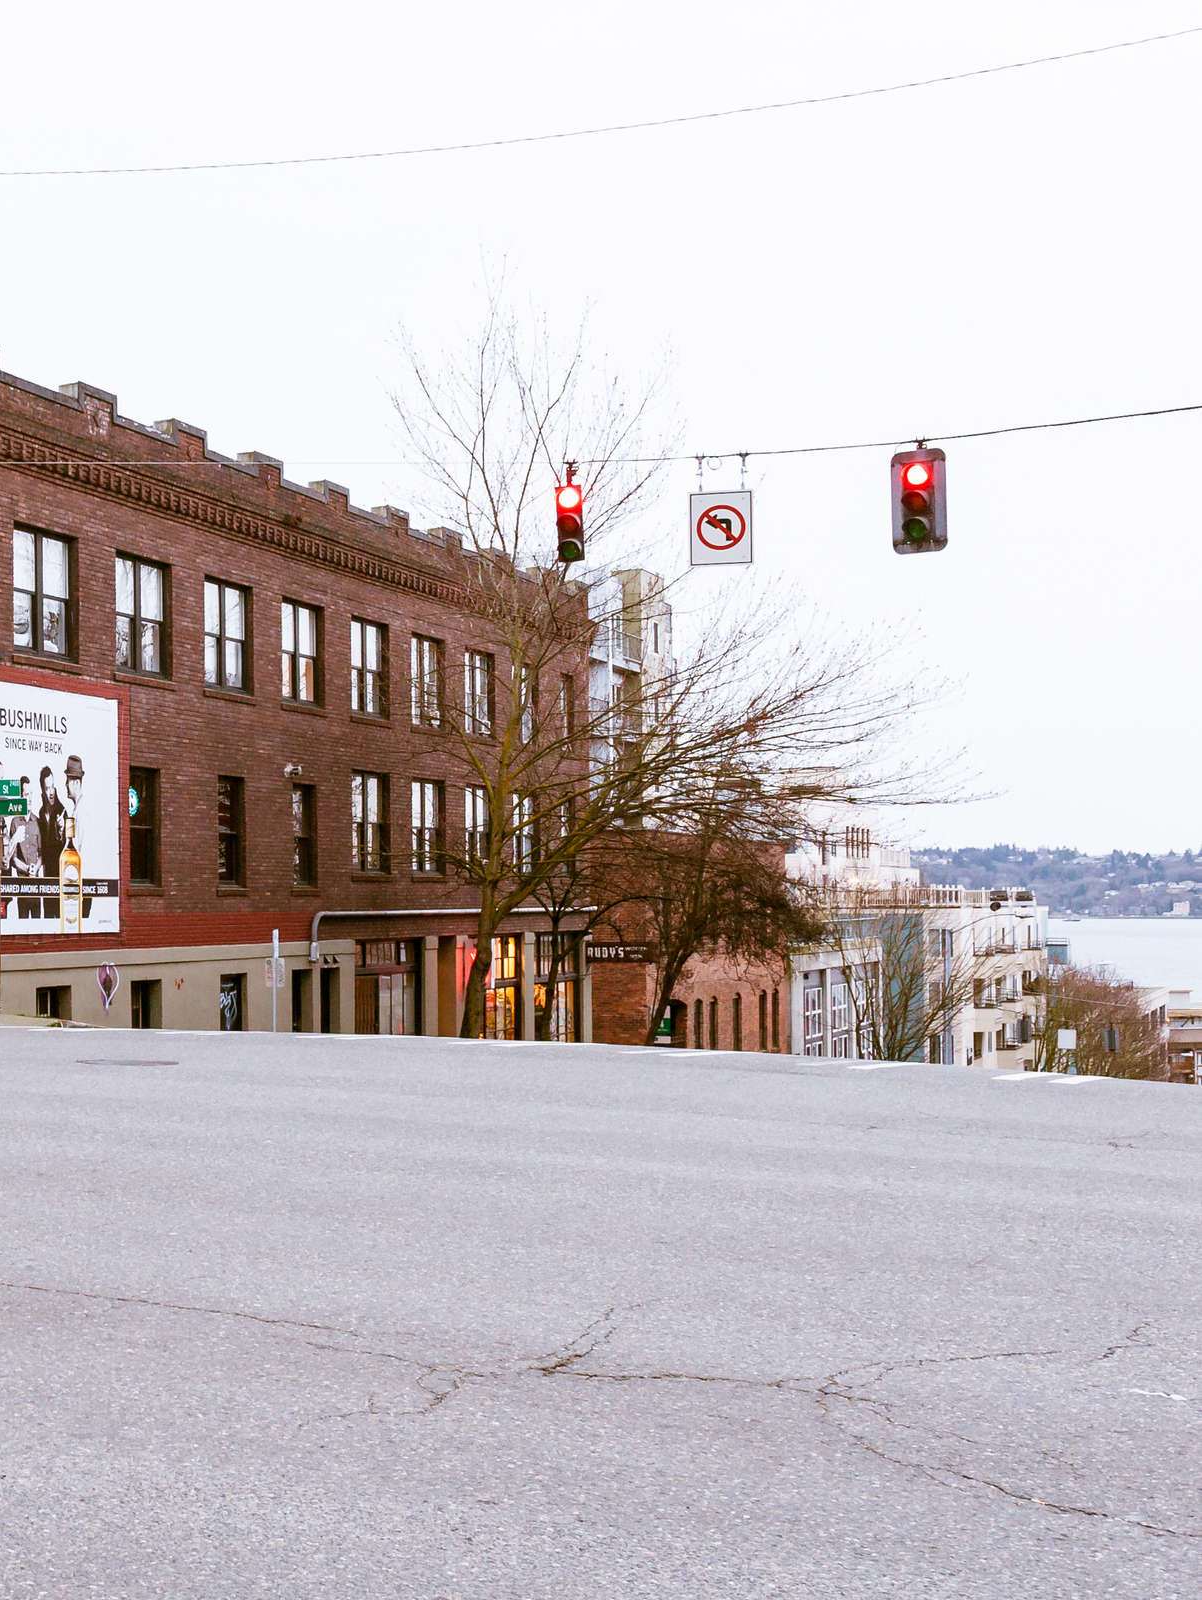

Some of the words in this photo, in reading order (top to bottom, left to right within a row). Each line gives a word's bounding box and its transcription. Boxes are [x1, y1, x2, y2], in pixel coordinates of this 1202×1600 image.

[0, 708, 67, 734] BUSHMILLS
[4, 737, 26, 750] SINCE
[28, 740, 42, 752] WAY
[44, 742, 62, 754] BACK
[8, 803, 23, 812] Ave
[0, 885, 19, 894] SHARED
[20, 885, 38, 894] AMONG
[82, 886, 96, 894] SINCE
[587, 945, 624, 958] RUDY'S
